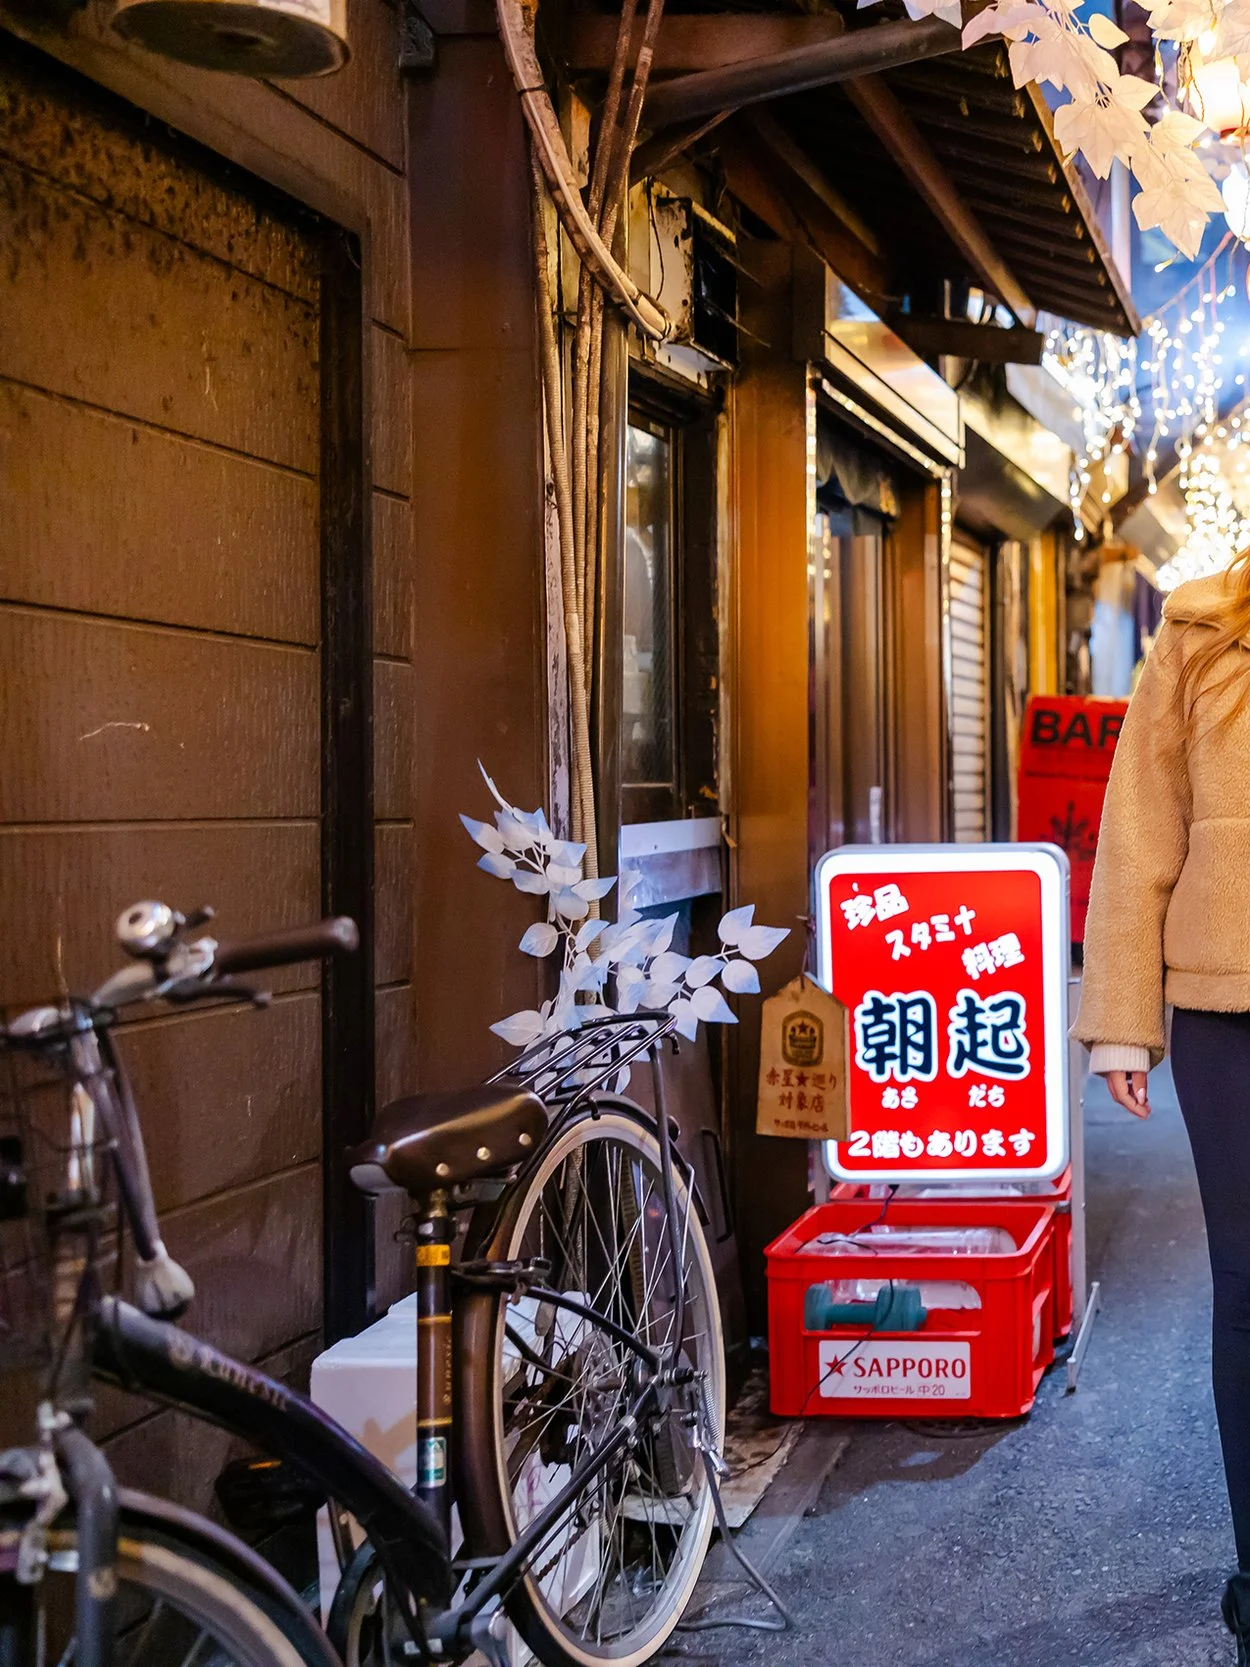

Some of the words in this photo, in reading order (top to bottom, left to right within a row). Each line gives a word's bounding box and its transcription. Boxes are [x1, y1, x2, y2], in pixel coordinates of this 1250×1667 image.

[840, 882, 910, 930] 珍品
[885, 905, 977, 961] スタミナ
[961, 932, 1025, 980] 料理
[857, 991, 1028, 1081] 朝起
[779, 1091, 825, 1113] 対象店
[881, 1086, 919, 1109] あさ
[968, 1083, 1006, 1108] だち
[847, 1128, 1036, 1159] 2階もあります
[853, 1356, 967, 1378] SAPPORO
[853, 1385, 915, 1395] サッポロビール
